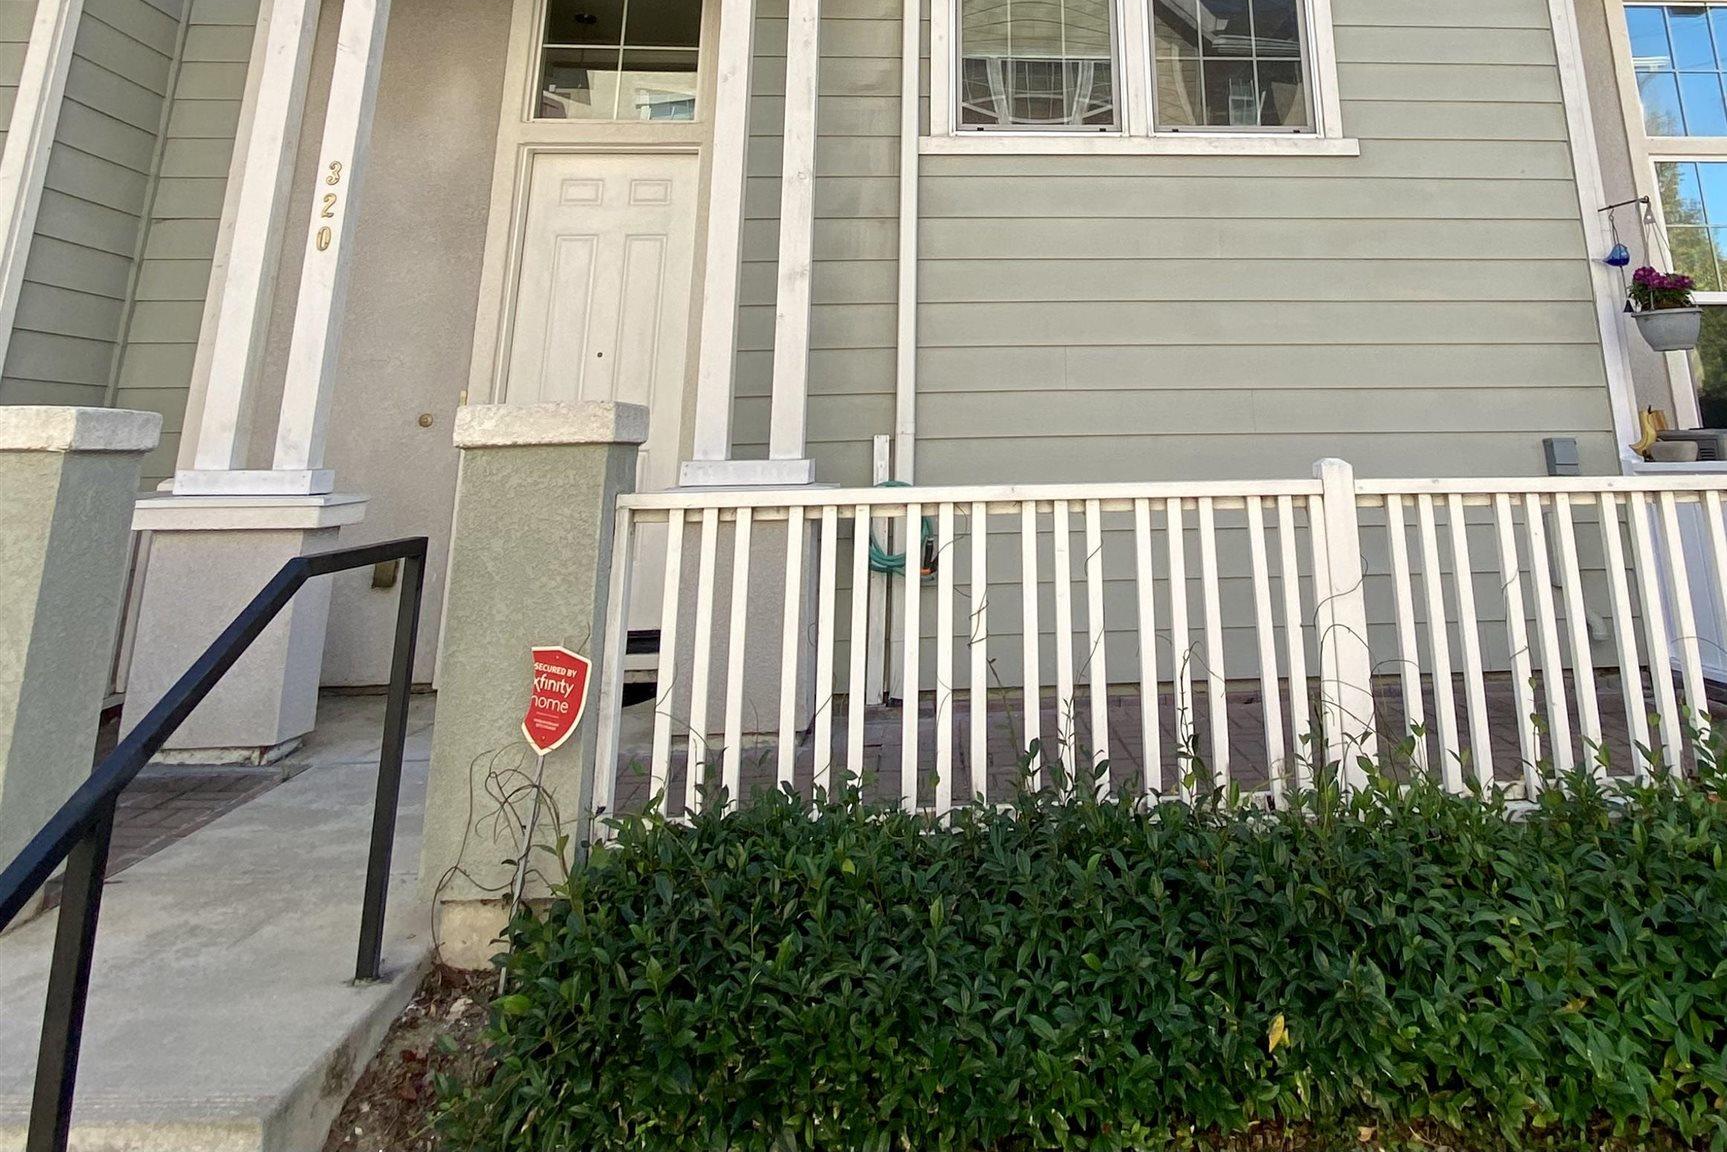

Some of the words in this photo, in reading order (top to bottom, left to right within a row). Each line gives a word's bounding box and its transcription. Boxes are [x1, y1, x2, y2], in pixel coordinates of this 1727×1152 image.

[316, 160, 343, 252] 320
[534, 662, 567, 676] SECURED
[567, 668, 577, 677] BY
